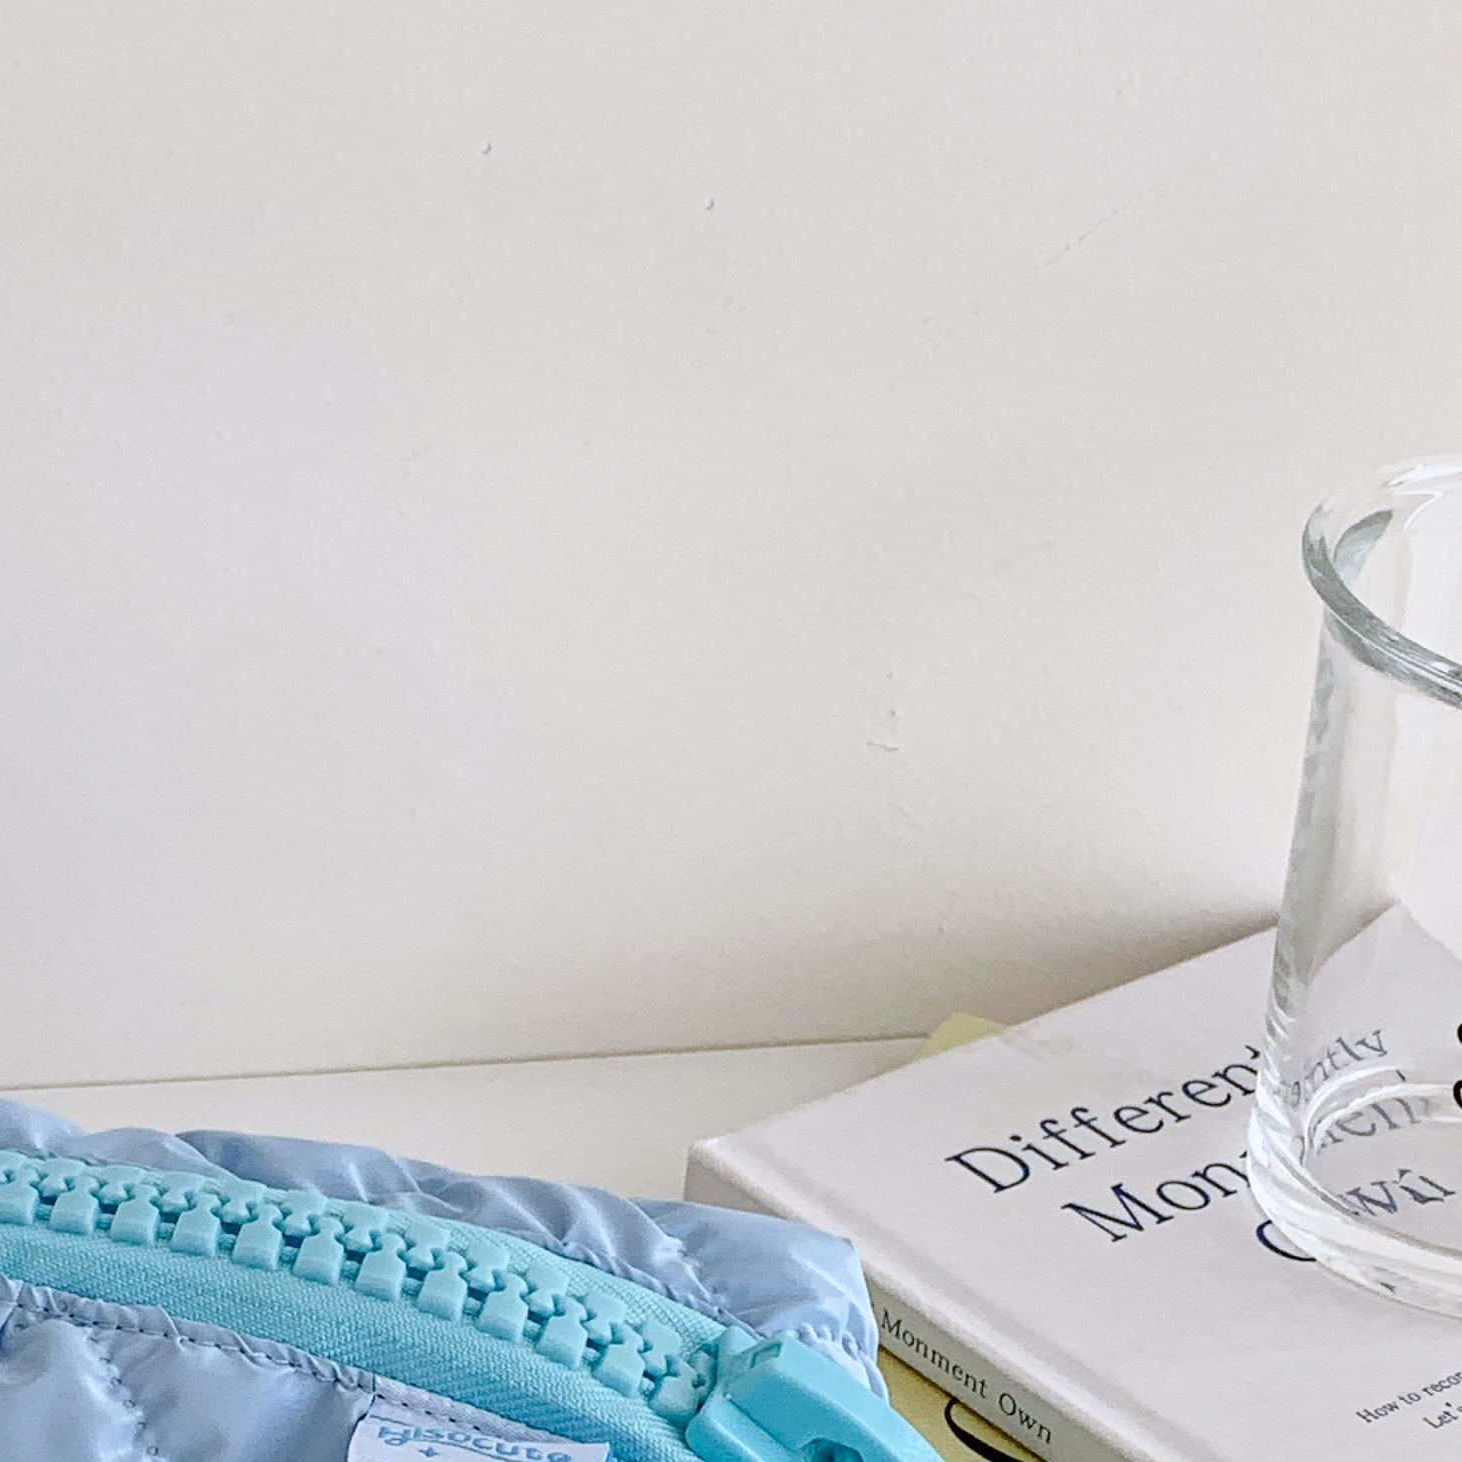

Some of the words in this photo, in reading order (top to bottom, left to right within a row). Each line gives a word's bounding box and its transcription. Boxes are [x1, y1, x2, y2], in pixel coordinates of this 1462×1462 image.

[880, 1309, 988, 1399] Monment
[999, 1392, 1052, 1444] Own
[1356, 1401, 1399, 1423] How
[1397, 1392, 1421, 1405] to
